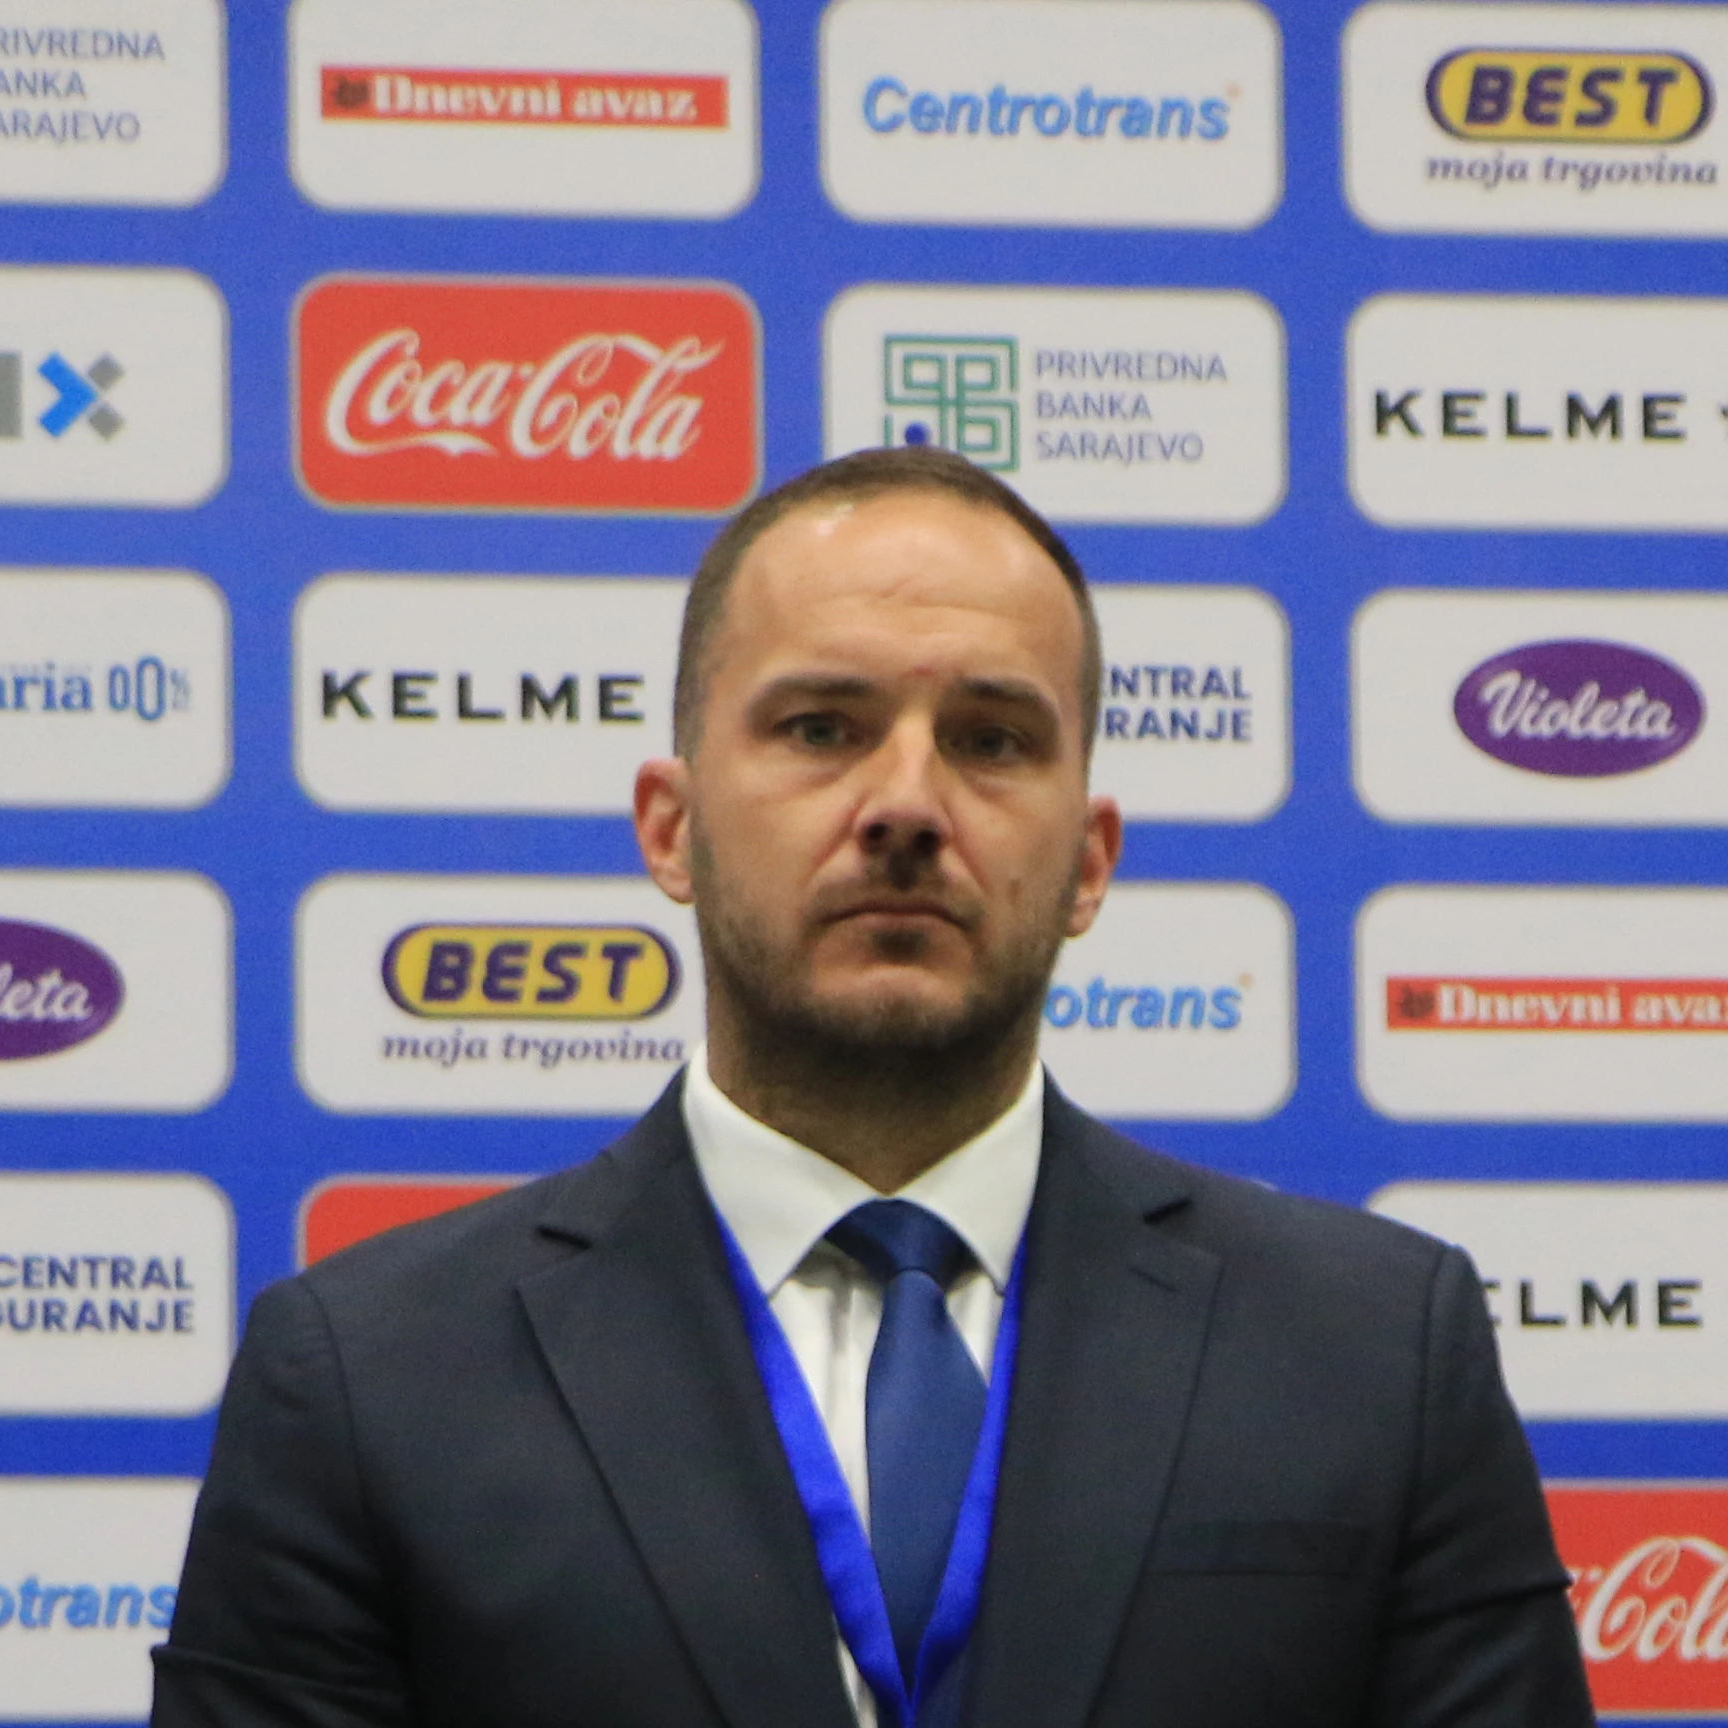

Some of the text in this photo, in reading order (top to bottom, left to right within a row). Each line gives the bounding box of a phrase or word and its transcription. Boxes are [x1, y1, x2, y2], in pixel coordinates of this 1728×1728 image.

[373, 74, 698, 121] Dnevni avaz
[861, 74, 1231, 140] Centrotrans
[1464, 64, 1681, 128] BEST
[1427, 150, 1717, 192] moja trgovina
[1035, 351, 1227, 382] PRIVREDNA
[326, 328, 725, 462] Coca-Cola
[1036, 392, 1151, 420] BANKA
[1375, 391, 1684, 441] KELME
[1036, 431, 1203, 466] SARAJEVO
[322, 672, 643, 723] KELME
[1102, 665, 1253, 698] NTRAL
[1479, 670, 1676, 737] Violeta
[421, 940, 647, 1002] BEST
[1437, 985, 1621, 1024] Dnevni
[383, 1030, 686, 1070] moja trgovina
